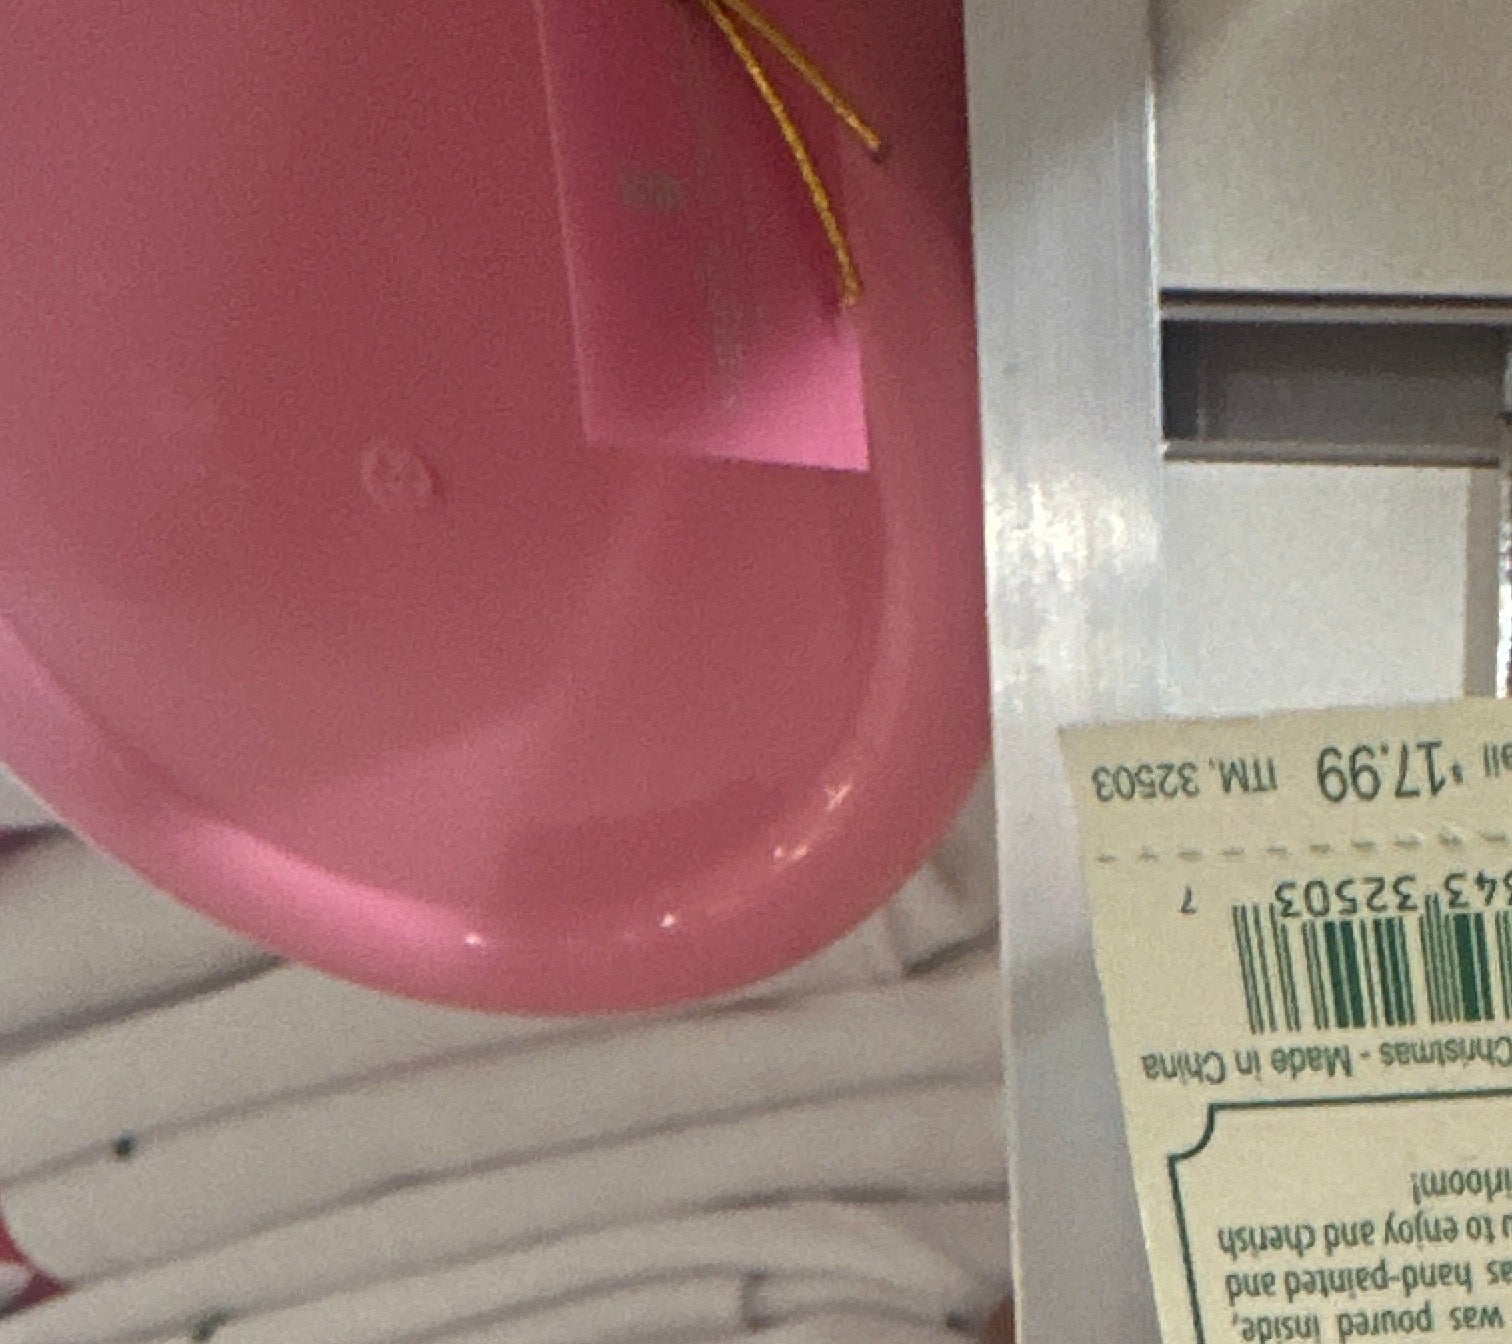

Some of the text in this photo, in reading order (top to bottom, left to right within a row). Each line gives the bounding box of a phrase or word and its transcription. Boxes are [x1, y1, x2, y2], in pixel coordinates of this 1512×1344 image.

[1090, 761, 1200, 803] 32503
[1208, 757, 1278, 796] ITM.
[1274, 874, 1418, 919] 32503
[1140, 1049, 1227, 1086] China
[1233, 1048, 1262, 1081] in
[1270, 1044, 1354, 1080] Made
[1217, 1223, 1315, 1261] cherish
[1323, 1219, 1376, 1257] and
[1384, 1209, 1460, 1250] enjoy
[1465, 1212, 1495, 1244] to
[1224, 1267, 1277, 1308] and
[1284, 1258, 1473, 1304] hand-painted
[1450, 1304, 1504, 1332] was
